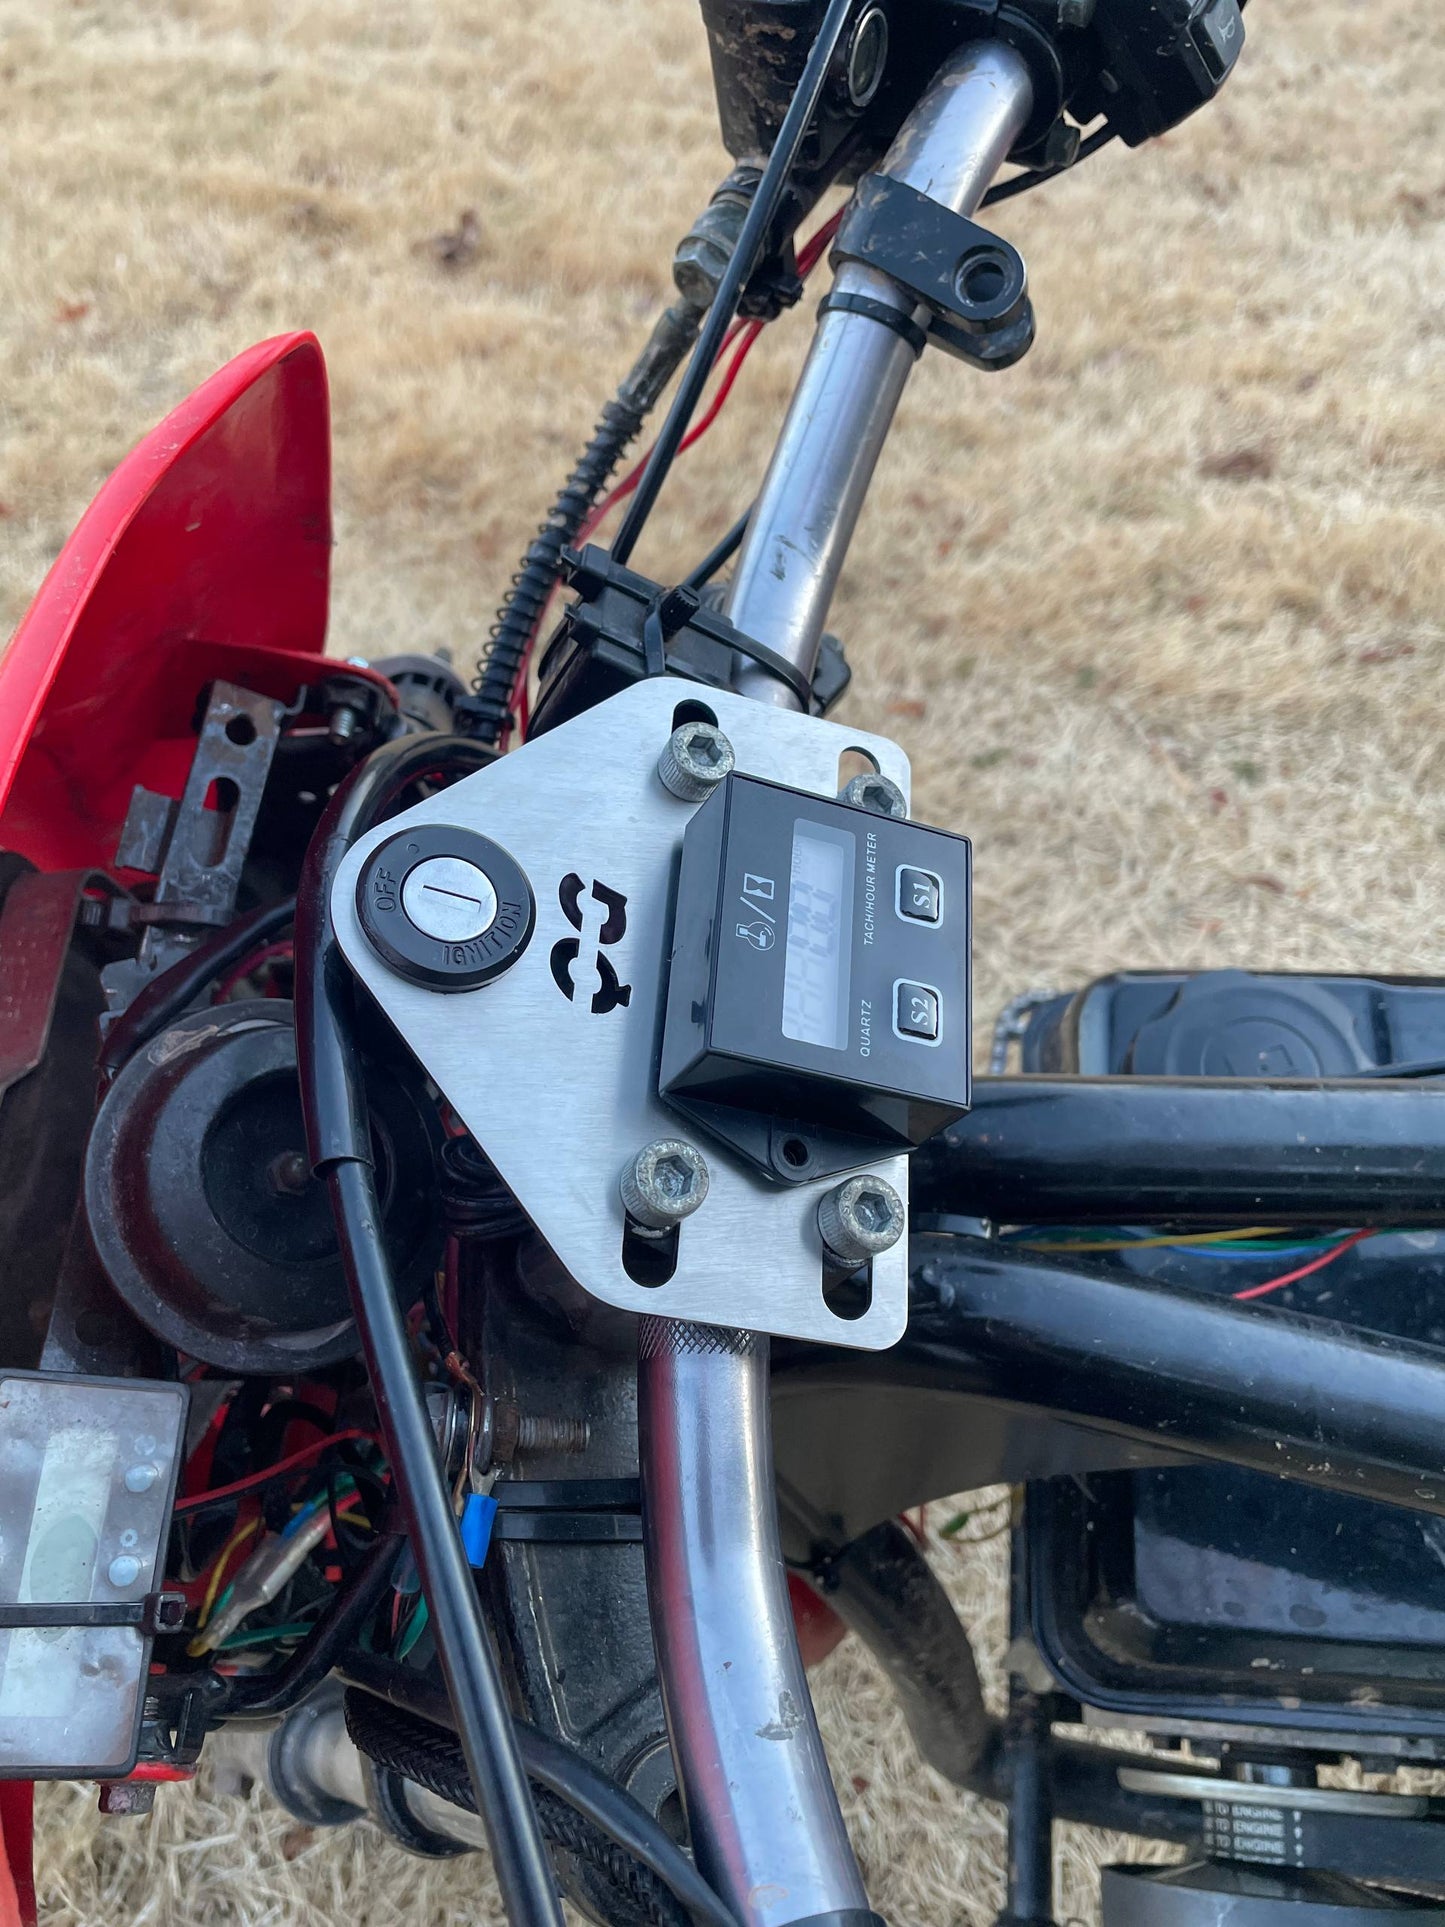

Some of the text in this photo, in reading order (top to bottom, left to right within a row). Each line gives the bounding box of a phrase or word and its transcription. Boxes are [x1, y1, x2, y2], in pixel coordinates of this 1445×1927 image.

[373, 867, 397, 913] OFF
[864, 832, 877, 945] TACH/HOUR METER
[913, 882, 931, 909] S1
[442, 901, 523, 965] IGNITION
[860, 999, 872, 1057] QUARTZ
[911, 997, 929, 1026] S2
